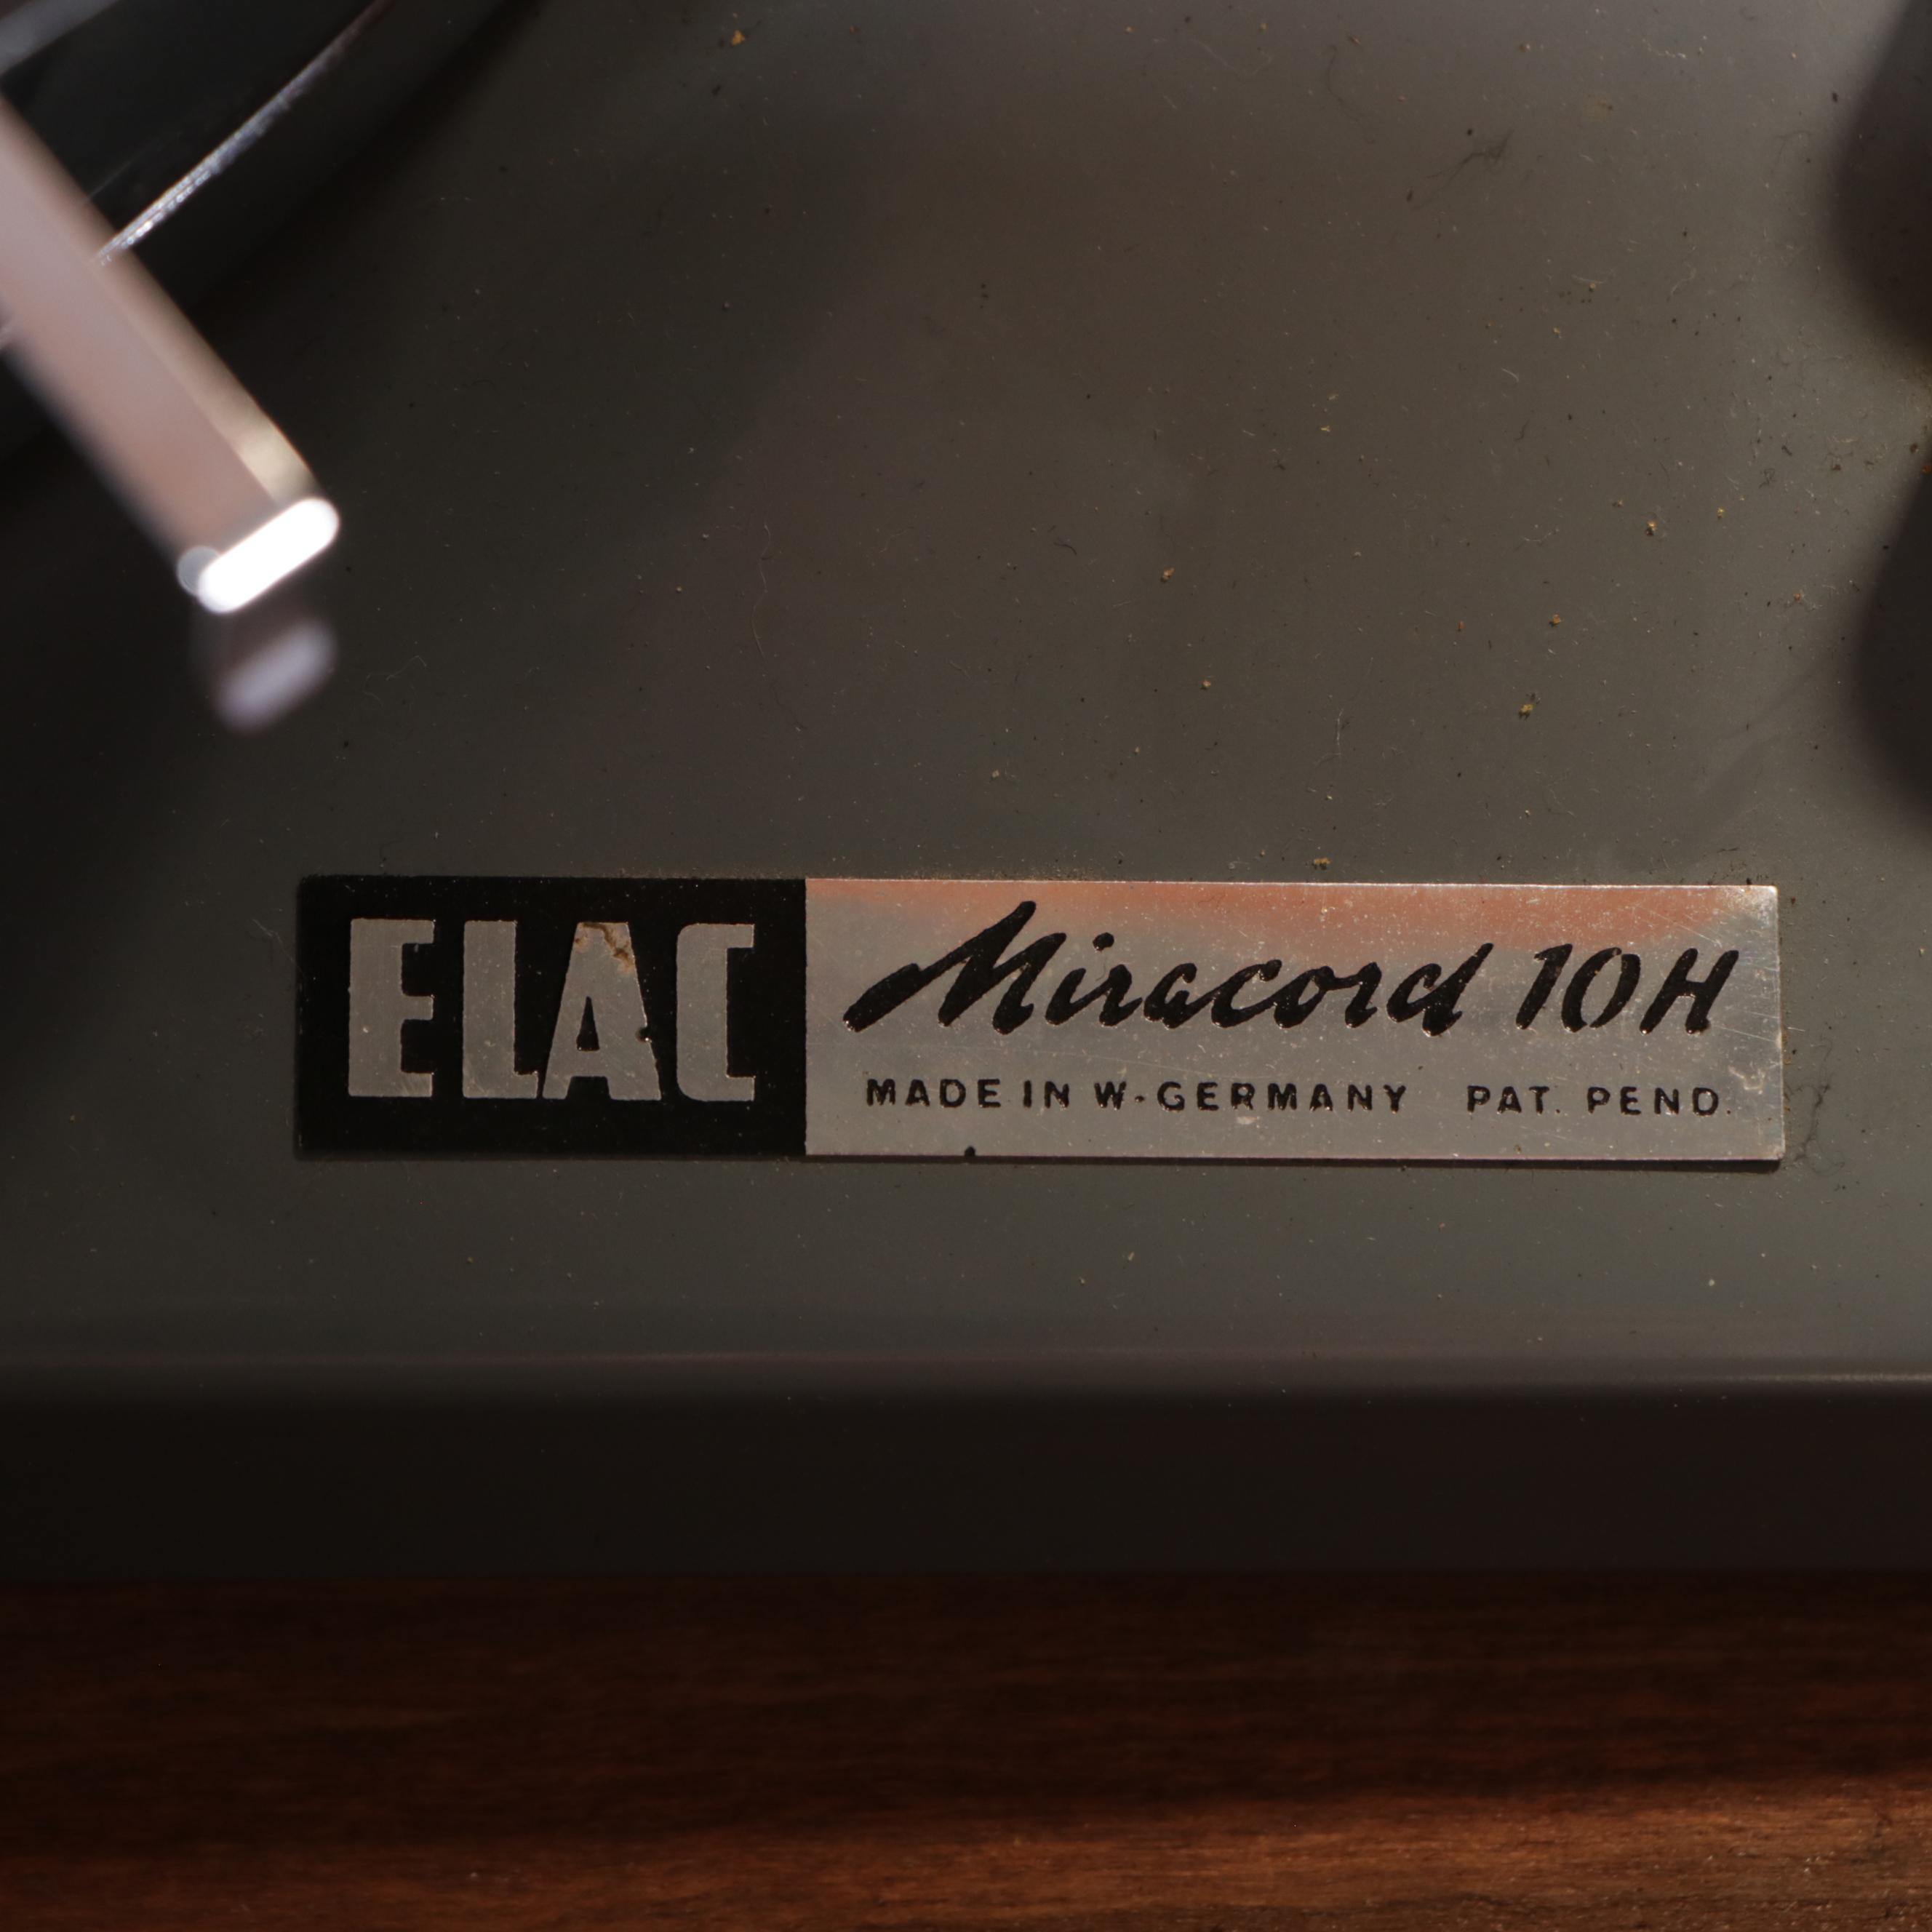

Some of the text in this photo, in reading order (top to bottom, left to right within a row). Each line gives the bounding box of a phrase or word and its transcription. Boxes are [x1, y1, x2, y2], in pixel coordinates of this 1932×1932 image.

[348, 918, 757, 1102] ELAC
[842, 901, 1739, 1037] Miracord 10H
[866, 1078, 1002, 1109] MADE
[1023, 1079, 1070, 1109] IN
[1467, 1085, 1561, 1114] PAT.
